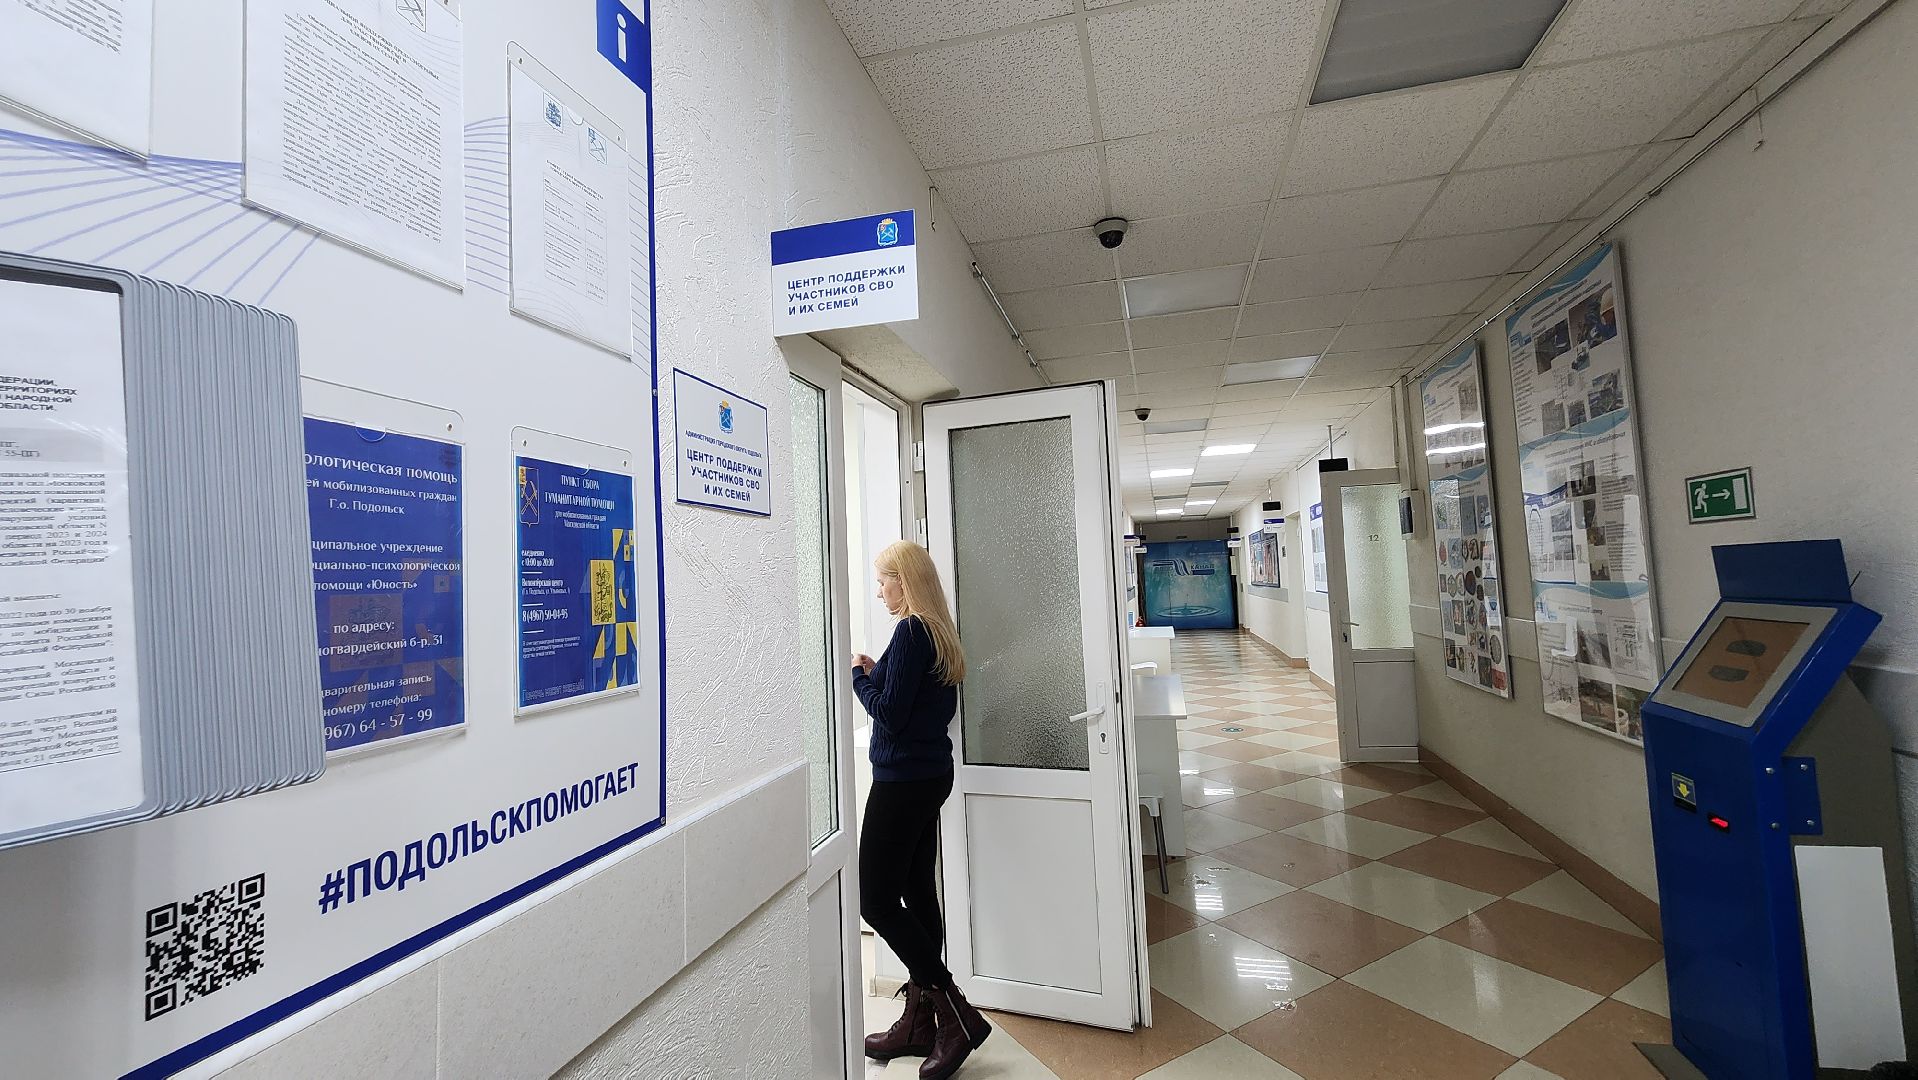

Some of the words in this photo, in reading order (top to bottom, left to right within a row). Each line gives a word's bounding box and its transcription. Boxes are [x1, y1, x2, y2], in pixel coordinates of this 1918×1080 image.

[788, 276, 825, 291] ЦЕНТР
[828, 265, 905, 283] ПОДДЕРЖКИ
[788, 284, 865, 303] УЧАСТНИКОВ
[869, 280, 894, 291] СВО
[789, 307, 796, 316] И
[799, 304, 814, 314] ИХ
[817, 297, 859, 311] СЕМЕЙ
[0, 385, 77, 396] ЕРРИТОРИЯХ
[5, 394, 72, 403] НАРОДНОЙ
[305, 453, 402, 476] ологическая
[406, 467, 458, 485] помощь
[686, 448, 714, 465] ЦЕНТР
[716, 457, 762, 478] ПОДДЕРЖКИ
[561, 474, 580, 488] ПУНКТ
[582, 478, 600, 491] СБОРА
[691, 465, 744, 487] УЧАСТНИКОВ
[746, 479, 760, 491] СВО
[306, 479, 319, 488] ей
[323, 479, 416, 498] мобилизованных
[418, 491, 457, 502] граждан
[704, 484, 710, 494] И
[712, 485, 723, 497] ИХ
[725, 488, 751, 502] СЕМЕЙ
[329, 499, 350, 510] Г.о.
[352, 500, 405, 514] Подольск
[46, 531, 70, 539] 2023
[85, 530, 107, 538] 2024
[1367, 534, 1380, 542] 12
[59, 539, 81, 547] 2023
[312, 540, 377, 552] ципальное
[380, 543, 443, 554] учреждение
[366, 579, 418, 591] «Юность»
[522, 610, 527, 622] 8
[526, 609, 545, 624] (4967)
[333, 624, 349, 634] по
[351, 620, 395, 634] адресу:
[433, 635, 443, 646] 31
[398, 674, 432, 686] запись
[323, 701, 367, 718] номеру
[369, 693, 422, 709] телефона:
[324, 723, 356, 740] 967)
[359, 718, 377, 733] 64
[389, 713, 405, 728] 57
[417, 708, 433, 722] 99
[34, 754, 45, 763] 21
[318, 762, 639, 915] #ПОДОЛЬСКПОМОГАЕТ
